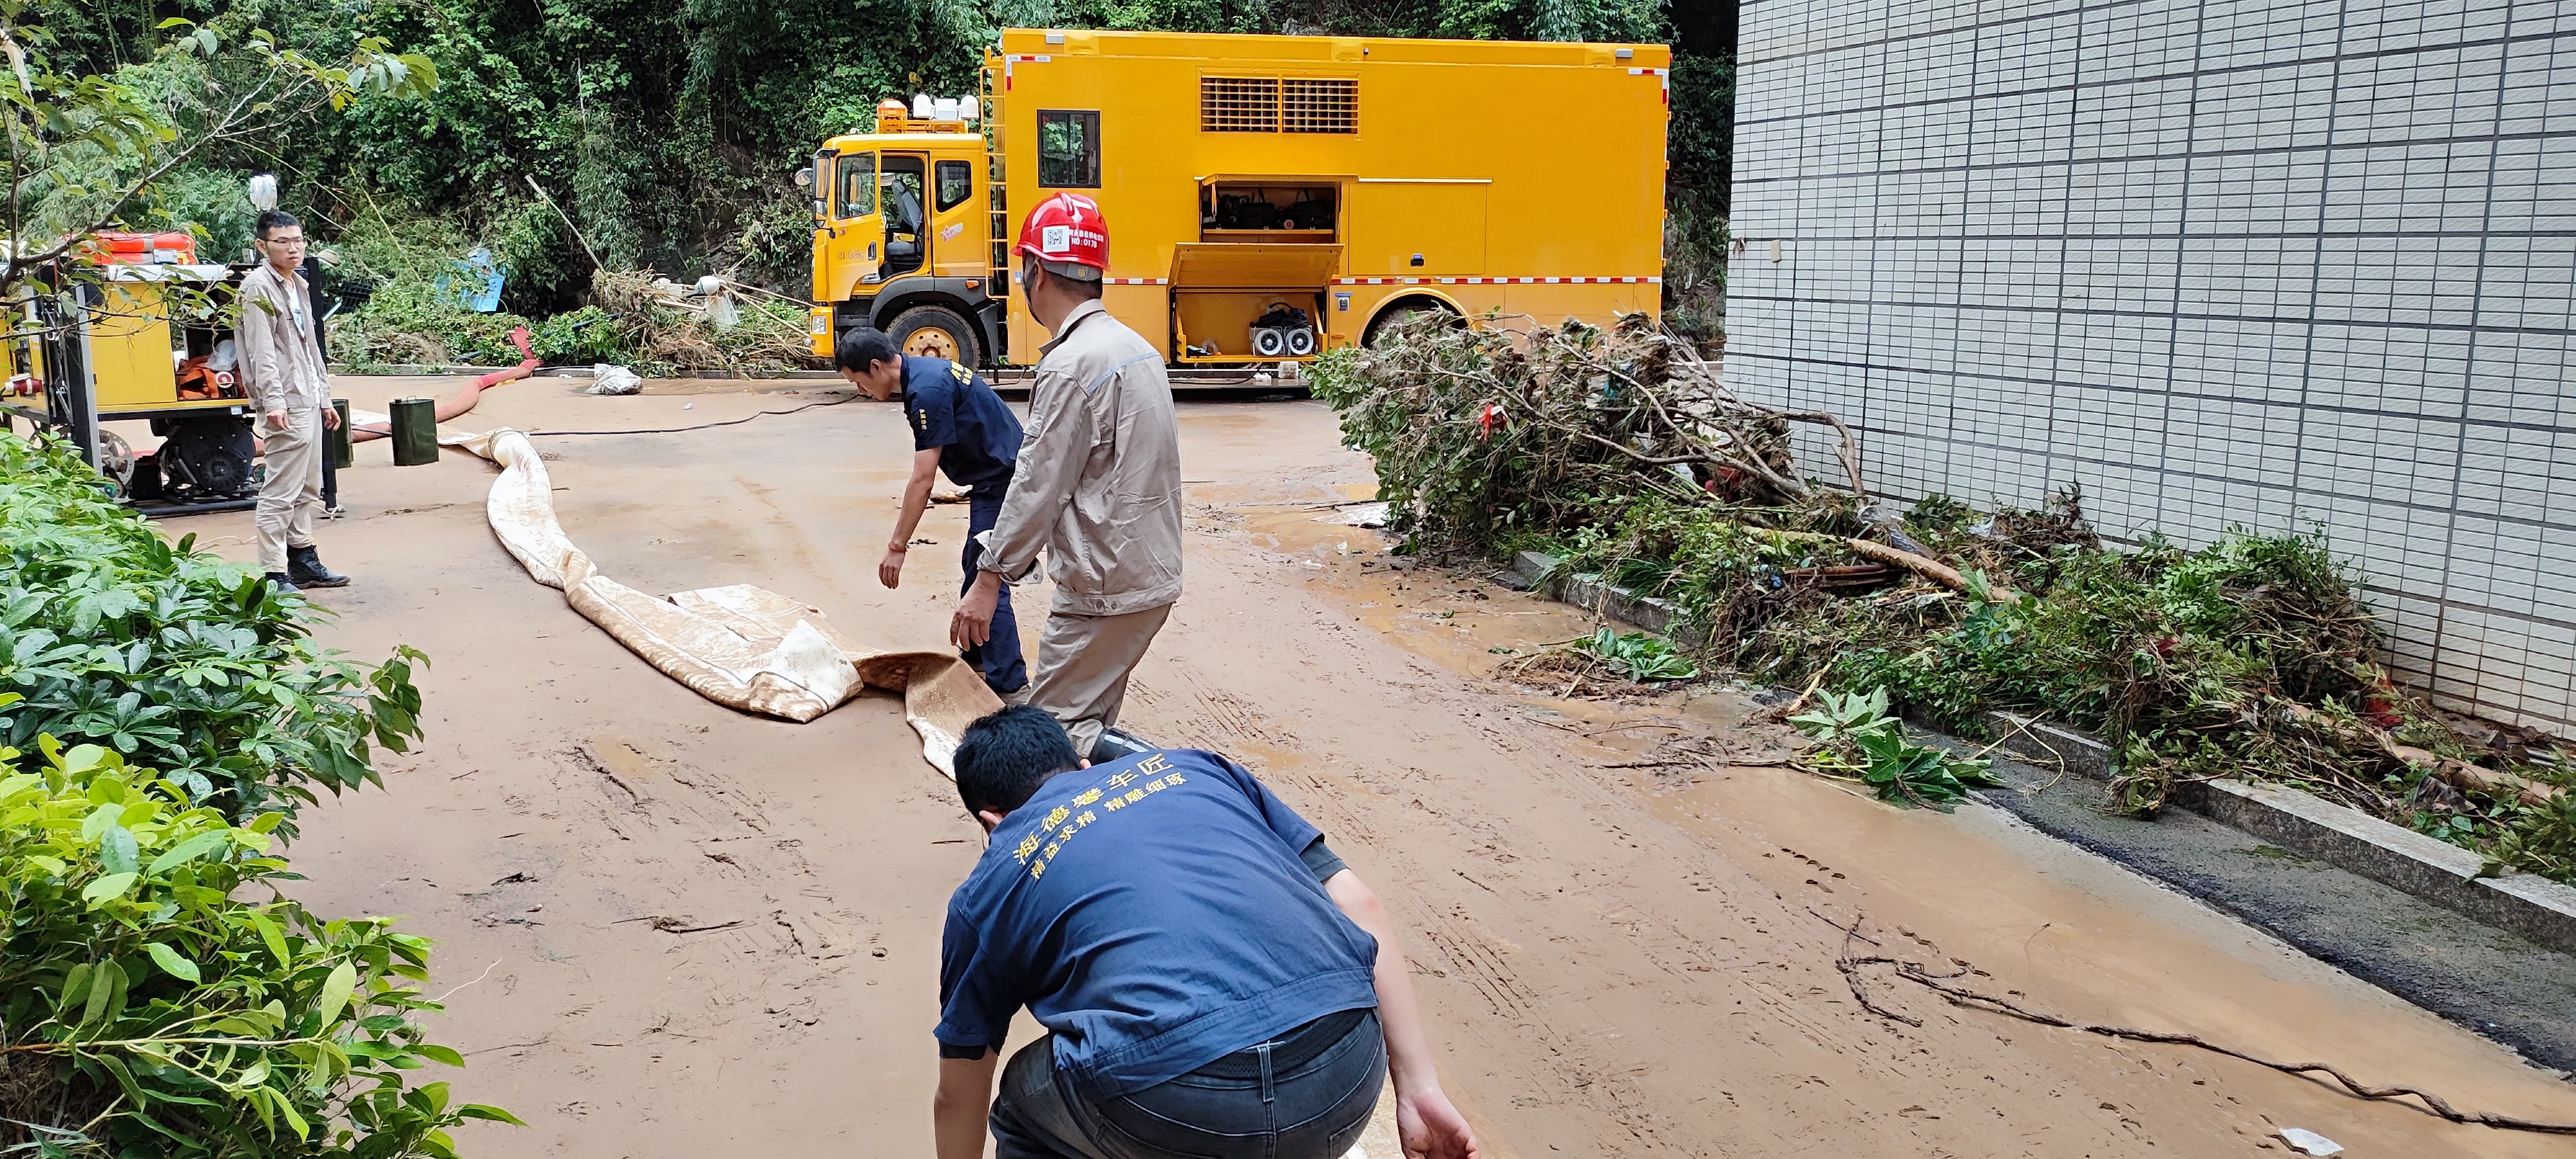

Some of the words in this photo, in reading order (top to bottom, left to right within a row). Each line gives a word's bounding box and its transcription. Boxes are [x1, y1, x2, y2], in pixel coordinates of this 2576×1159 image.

[1031, 809, 1097, 882] 精益求精
[1103, 772, 1188, 812] 精雕细琢
